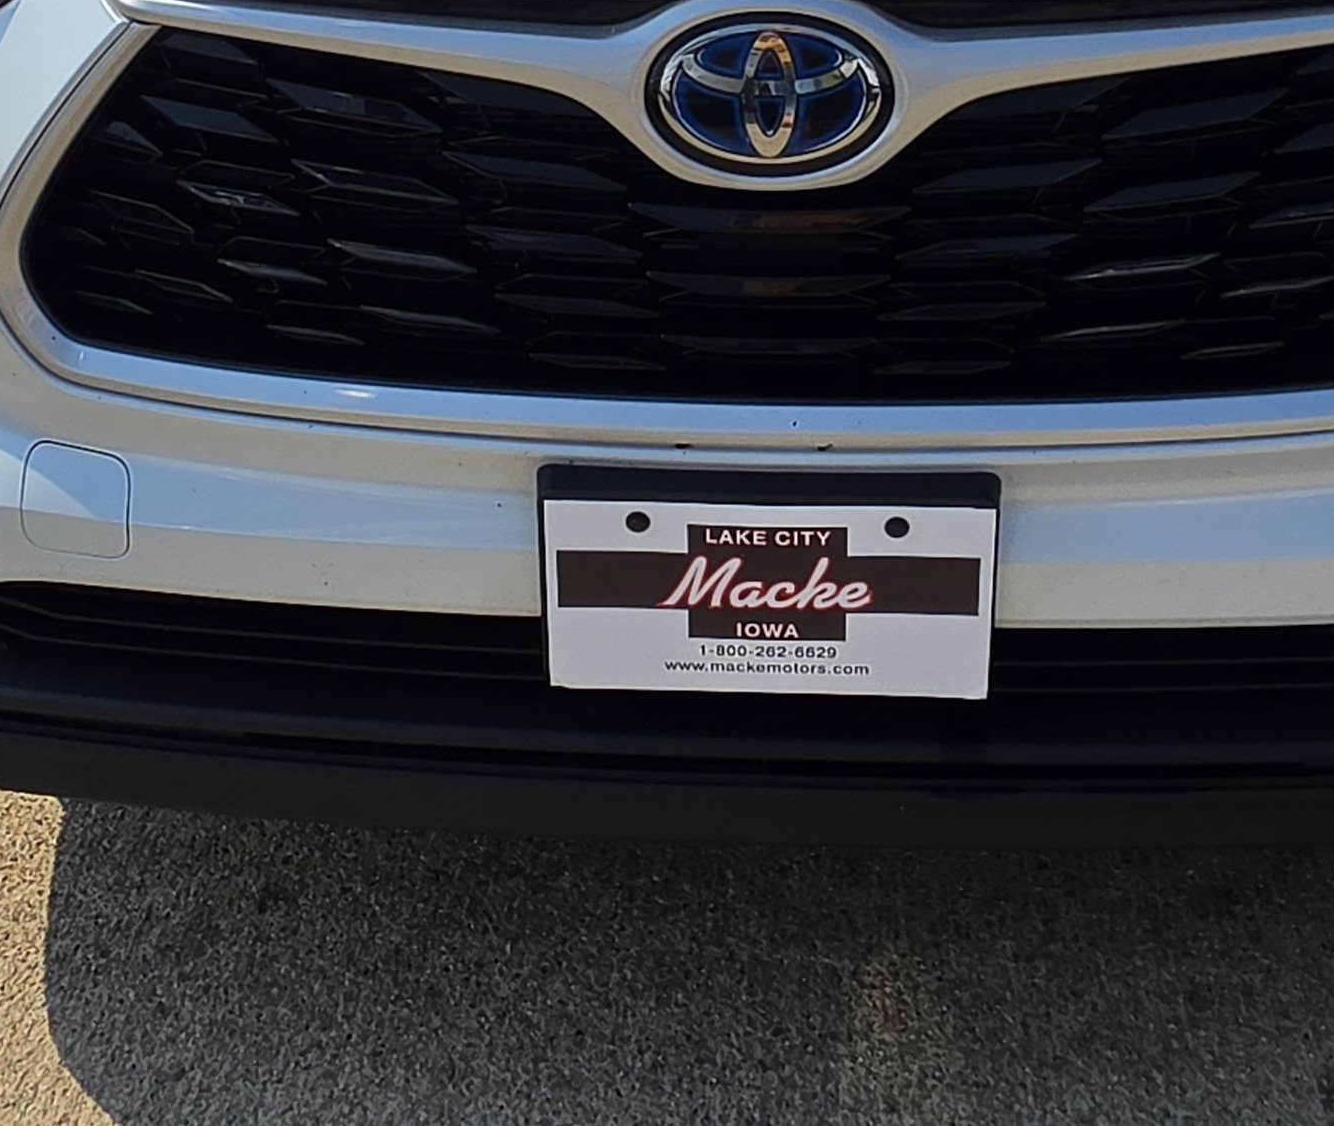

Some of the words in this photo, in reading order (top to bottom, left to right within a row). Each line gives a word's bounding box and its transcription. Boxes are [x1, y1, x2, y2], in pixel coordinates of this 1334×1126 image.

[705, 528, 767, 545] LAKE
[774, 530, 831, 546] CITY
[657, 556, 872, 609] Macke
[736, 622, 799, 638] IOWA
[700, 645, 838, 659] 1-800-262-6629
[665, 661, 870, 675] www.mackemotors.com
